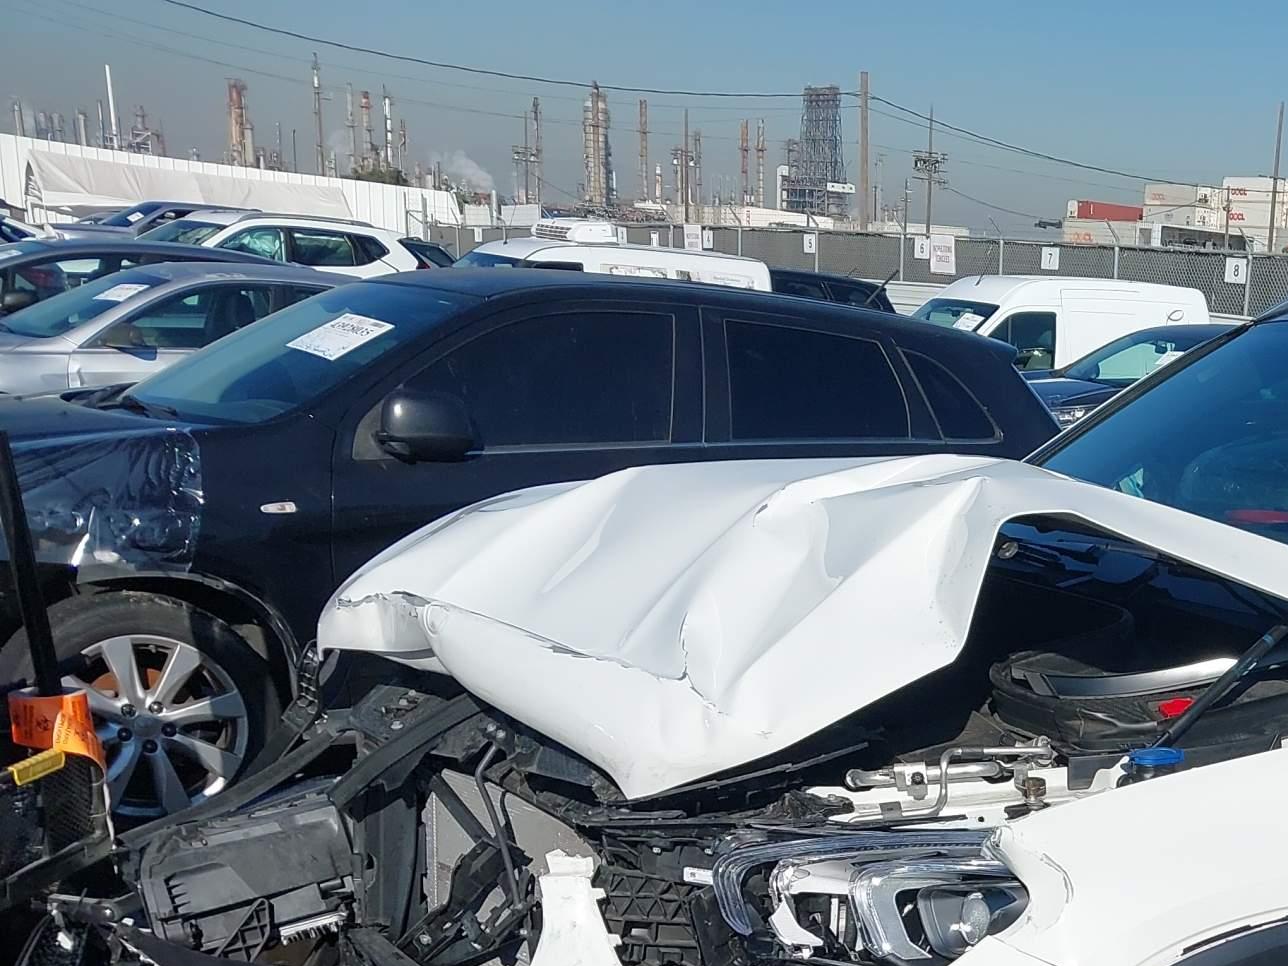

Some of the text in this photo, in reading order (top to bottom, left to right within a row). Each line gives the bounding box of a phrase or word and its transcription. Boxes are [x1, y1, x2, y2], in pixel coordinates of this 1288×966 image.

[1229, 212, 1245, 221] OOCL
[807, 238, 814, 249] 5
[919, 242, 925, 254] 6
[1047, 253, 1054, 264] 7
[1233, 264, 1239, 277] 8
